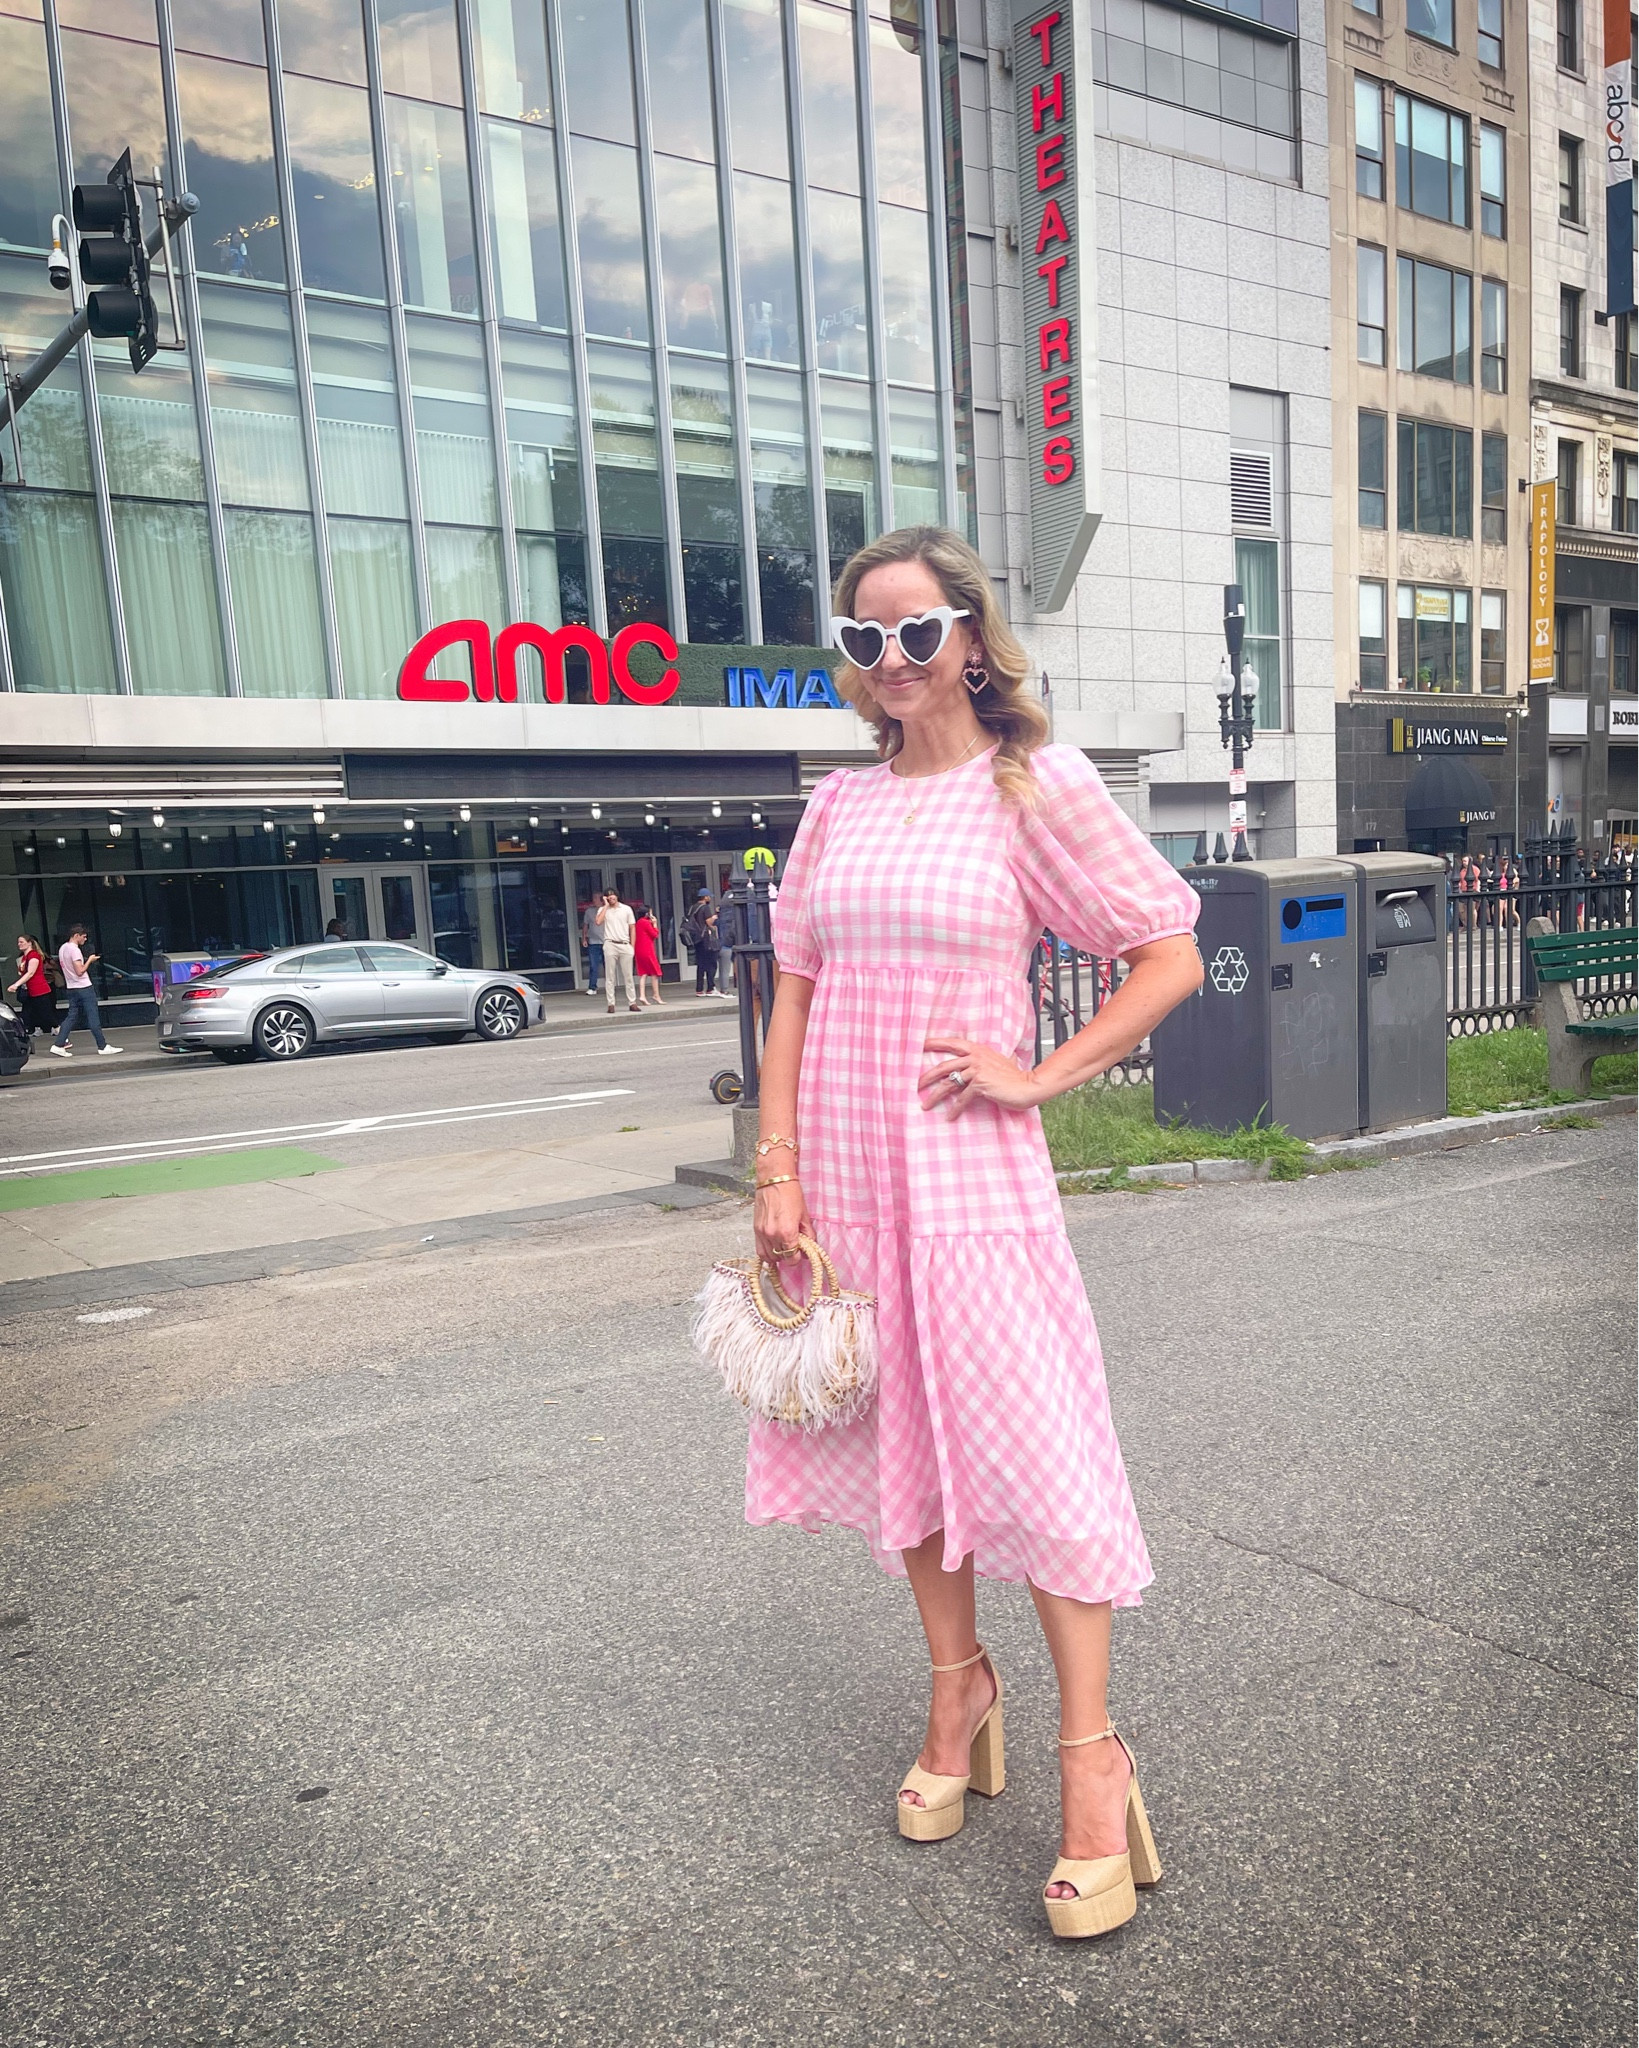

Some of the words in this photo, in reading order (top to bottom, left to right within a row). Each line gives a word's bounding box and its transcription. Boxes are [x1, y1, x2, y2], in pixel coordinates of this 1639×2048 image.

[1030, 12, 1074, 485] THEATRES
[1538, 493, 1549, 608] TRAPOLOGY
[724, 666, 854, 708] IMA
[1416, 728, 1451, 748] JIANG
[1454, 729, 1479, 745] NAN
[1365, 822, 1377, 831] 177
[1466, 811, 1489, 823] JIANG
